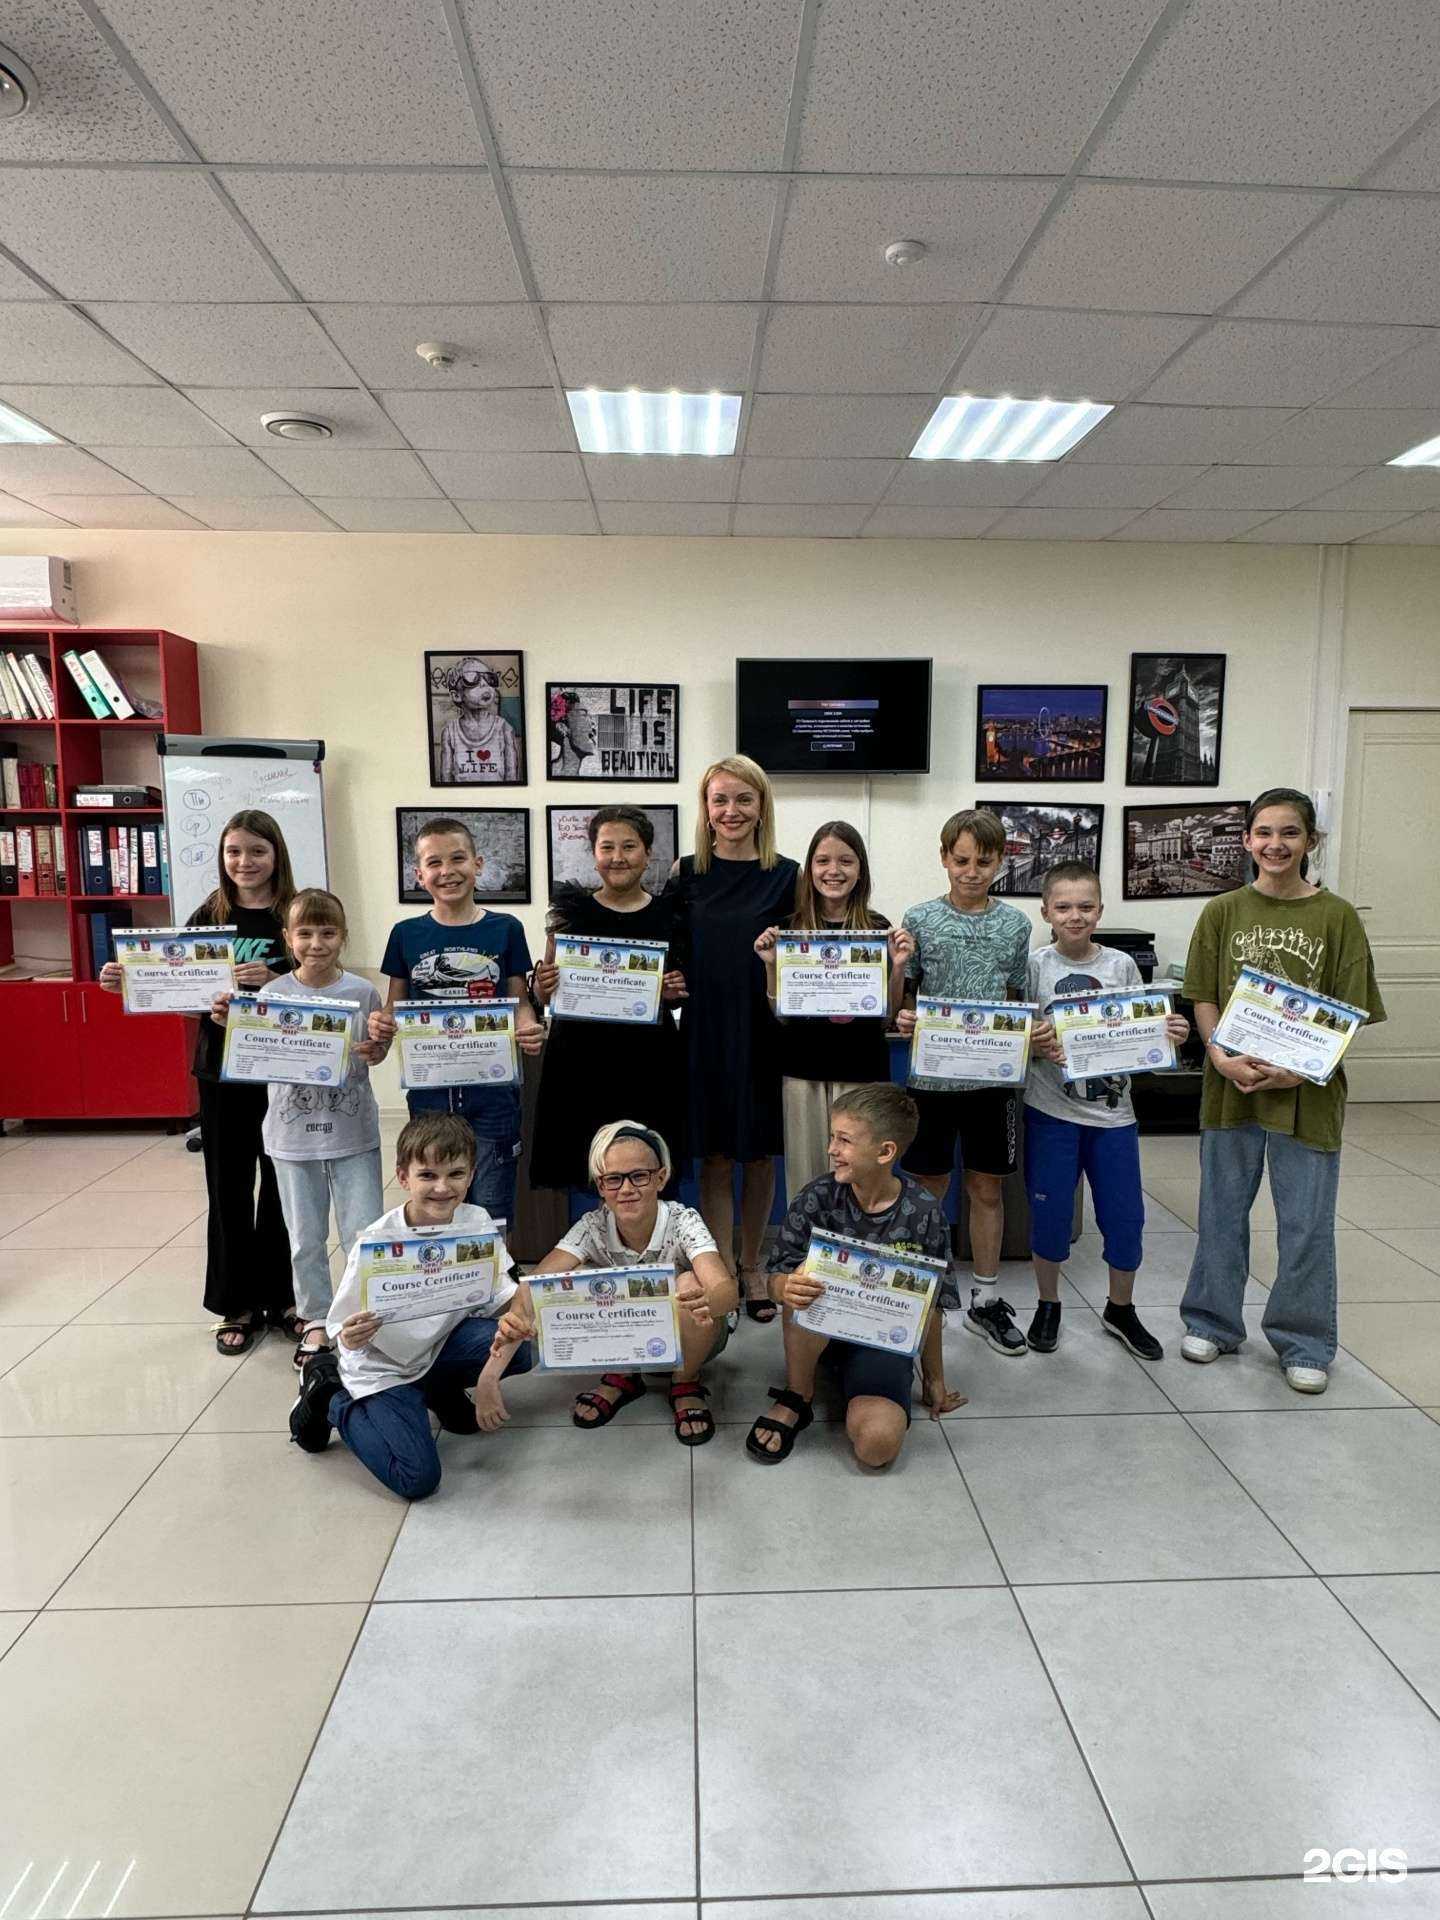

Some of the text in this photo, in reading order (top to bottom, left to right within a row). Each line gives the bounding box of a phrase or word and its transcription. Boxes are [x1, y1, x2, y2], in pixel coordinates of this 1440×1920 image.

[610, 689, 672, 716] LIFE
[642, 721, 666, 745] IS
[460, 763, 498, 773] LIFE
[601, 751, 673, 773] BEAUTIFUL
[232, 938, 275, 962] IKE
[1230, 925, 1325, 970] Celestial
[136, 968, 219, 977] Course Certificate
[569, 973, 647, 987] Course Certificate
[792, 971, 871, 980] Course Certificate
[1074, 1026, 1157, 1042] Course Certificate
[1243, 1007, 1329, 1045] Course Certificate
[244, 1033, 332, 1049] Course Certificate
[414, 1041, 498, 1051] Course Certificate
[930, 1034, 1013, 1048] Course Certificate
[382, 1269, 480, 1292] Course Certificate
[858, 1288, 911, 1310] Certificate
[556, 1308, 657, 1321] Course Certificate
